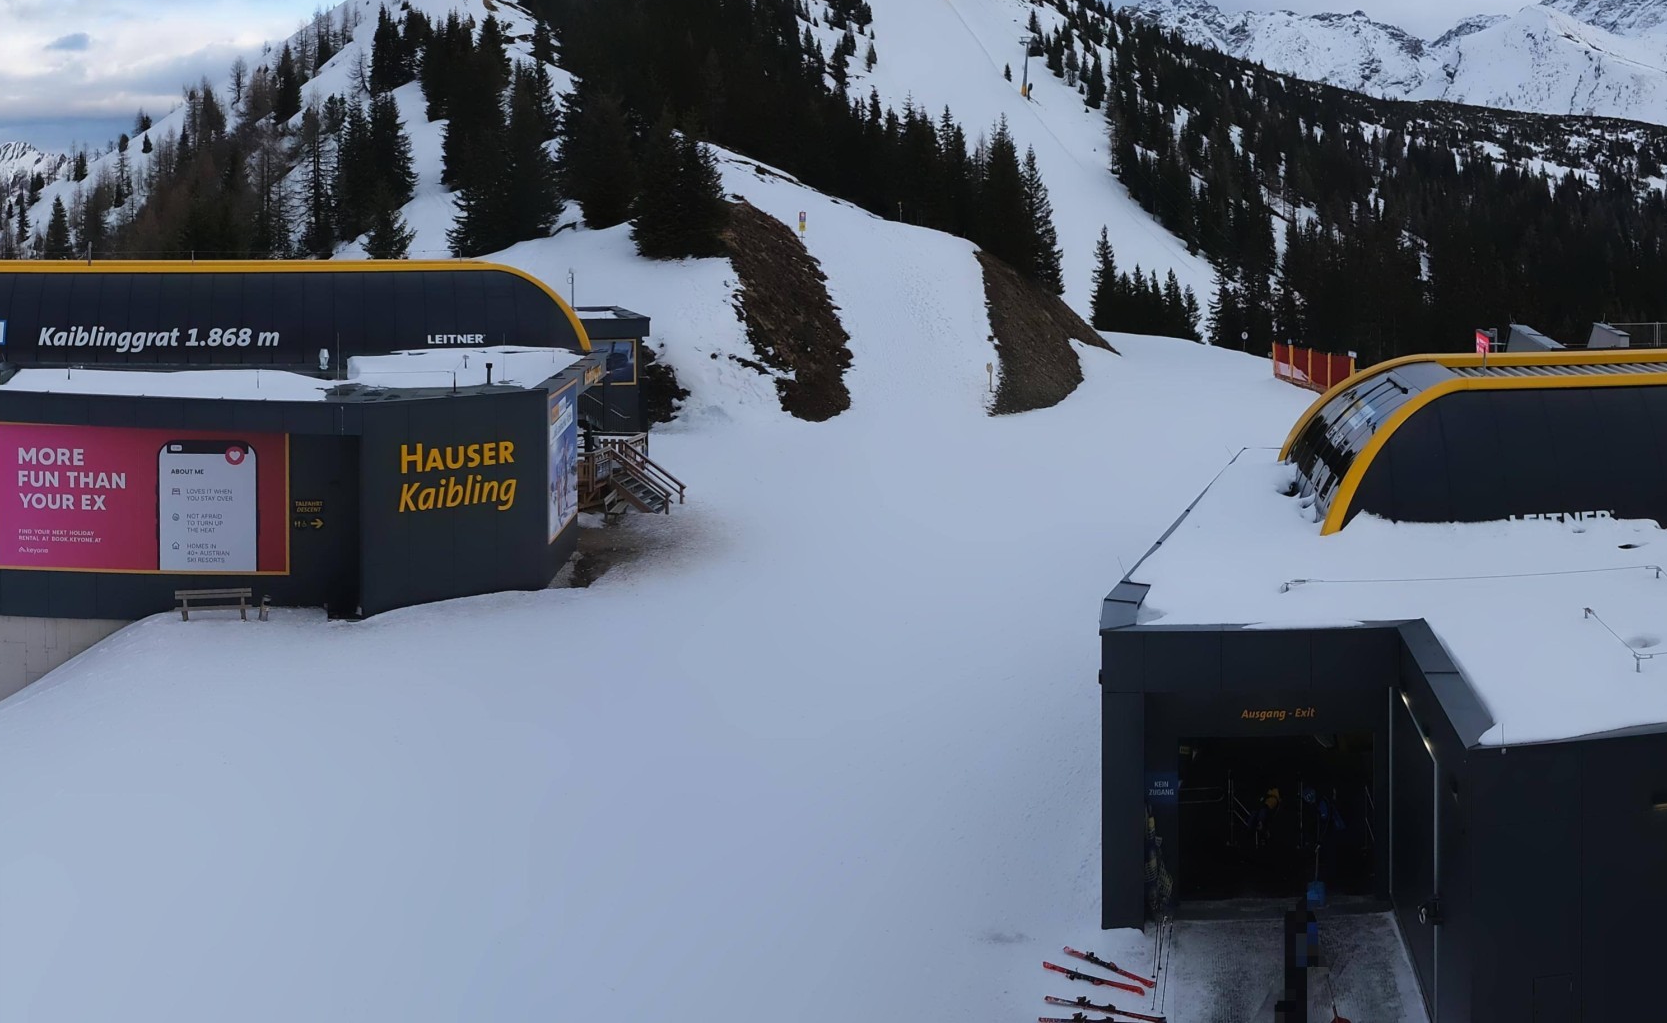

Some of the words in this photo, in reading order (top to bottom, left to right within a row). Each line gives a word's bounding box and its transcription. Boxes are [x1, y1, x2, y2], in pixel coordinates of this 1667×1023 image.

[38, 326, 180, 353] Kaiblinggrat
[185, 327, 252, 346] 1.868
[257, 330, 280, 347] m
[427, 334, 485, 344] LEITNER
[18, 447, 84, 466] MORE
[400, 440, 515, 474] HAUSER
[18, 470, 59, 488] FUN
[66, 471, 126, 489] THAN
[19, 493, 74, 510] YOUR
[81, 494, 106, 511] EX
[398, 474, 517, 513] Kaibling
[1241, 709, 1286, 721] Ausgang
[1295, 707, 1316, 718] Exit
[1148, 788, 1174, 796] ZUGANG
[1154, 780, 1169, 788] KEIN
